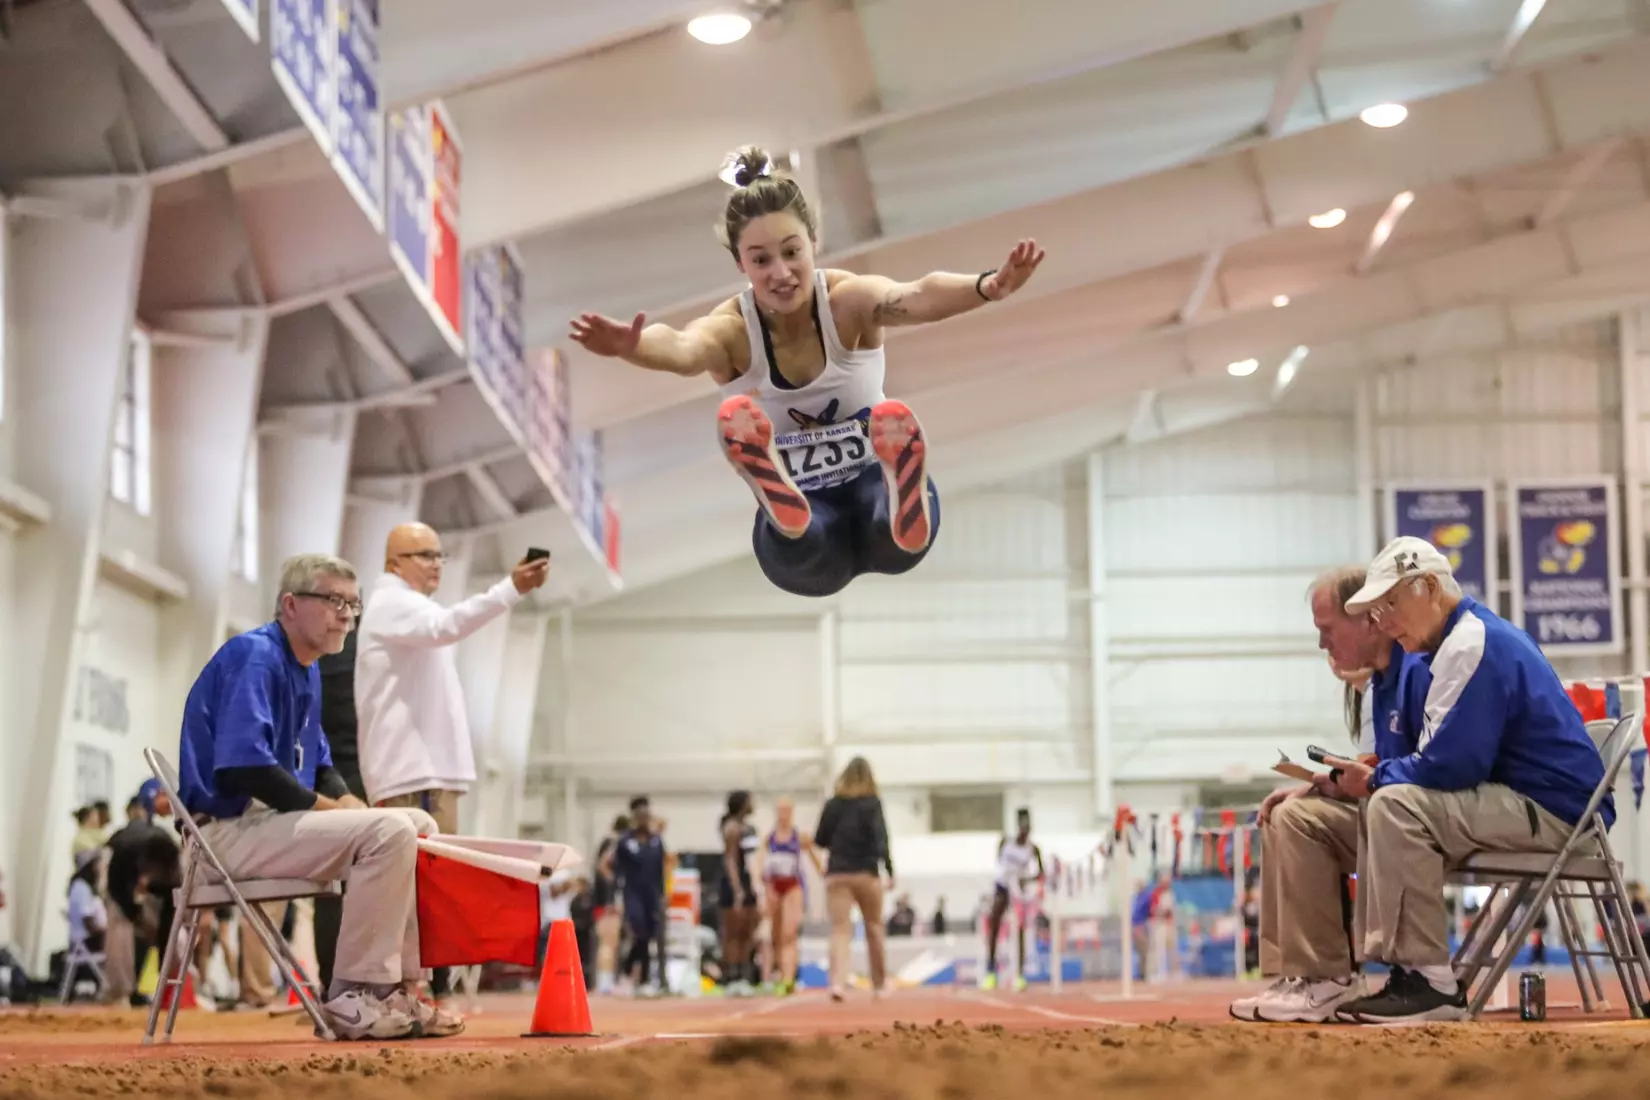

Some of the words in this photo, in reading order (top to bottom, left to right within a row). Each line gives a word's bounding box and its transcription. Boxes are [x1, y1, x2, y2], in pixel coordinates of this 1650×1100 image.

[815, 432, 822, 440] OF
[826, 425, 855, 437] KANSAS
[1538, 612, 1601, 641] 1966
